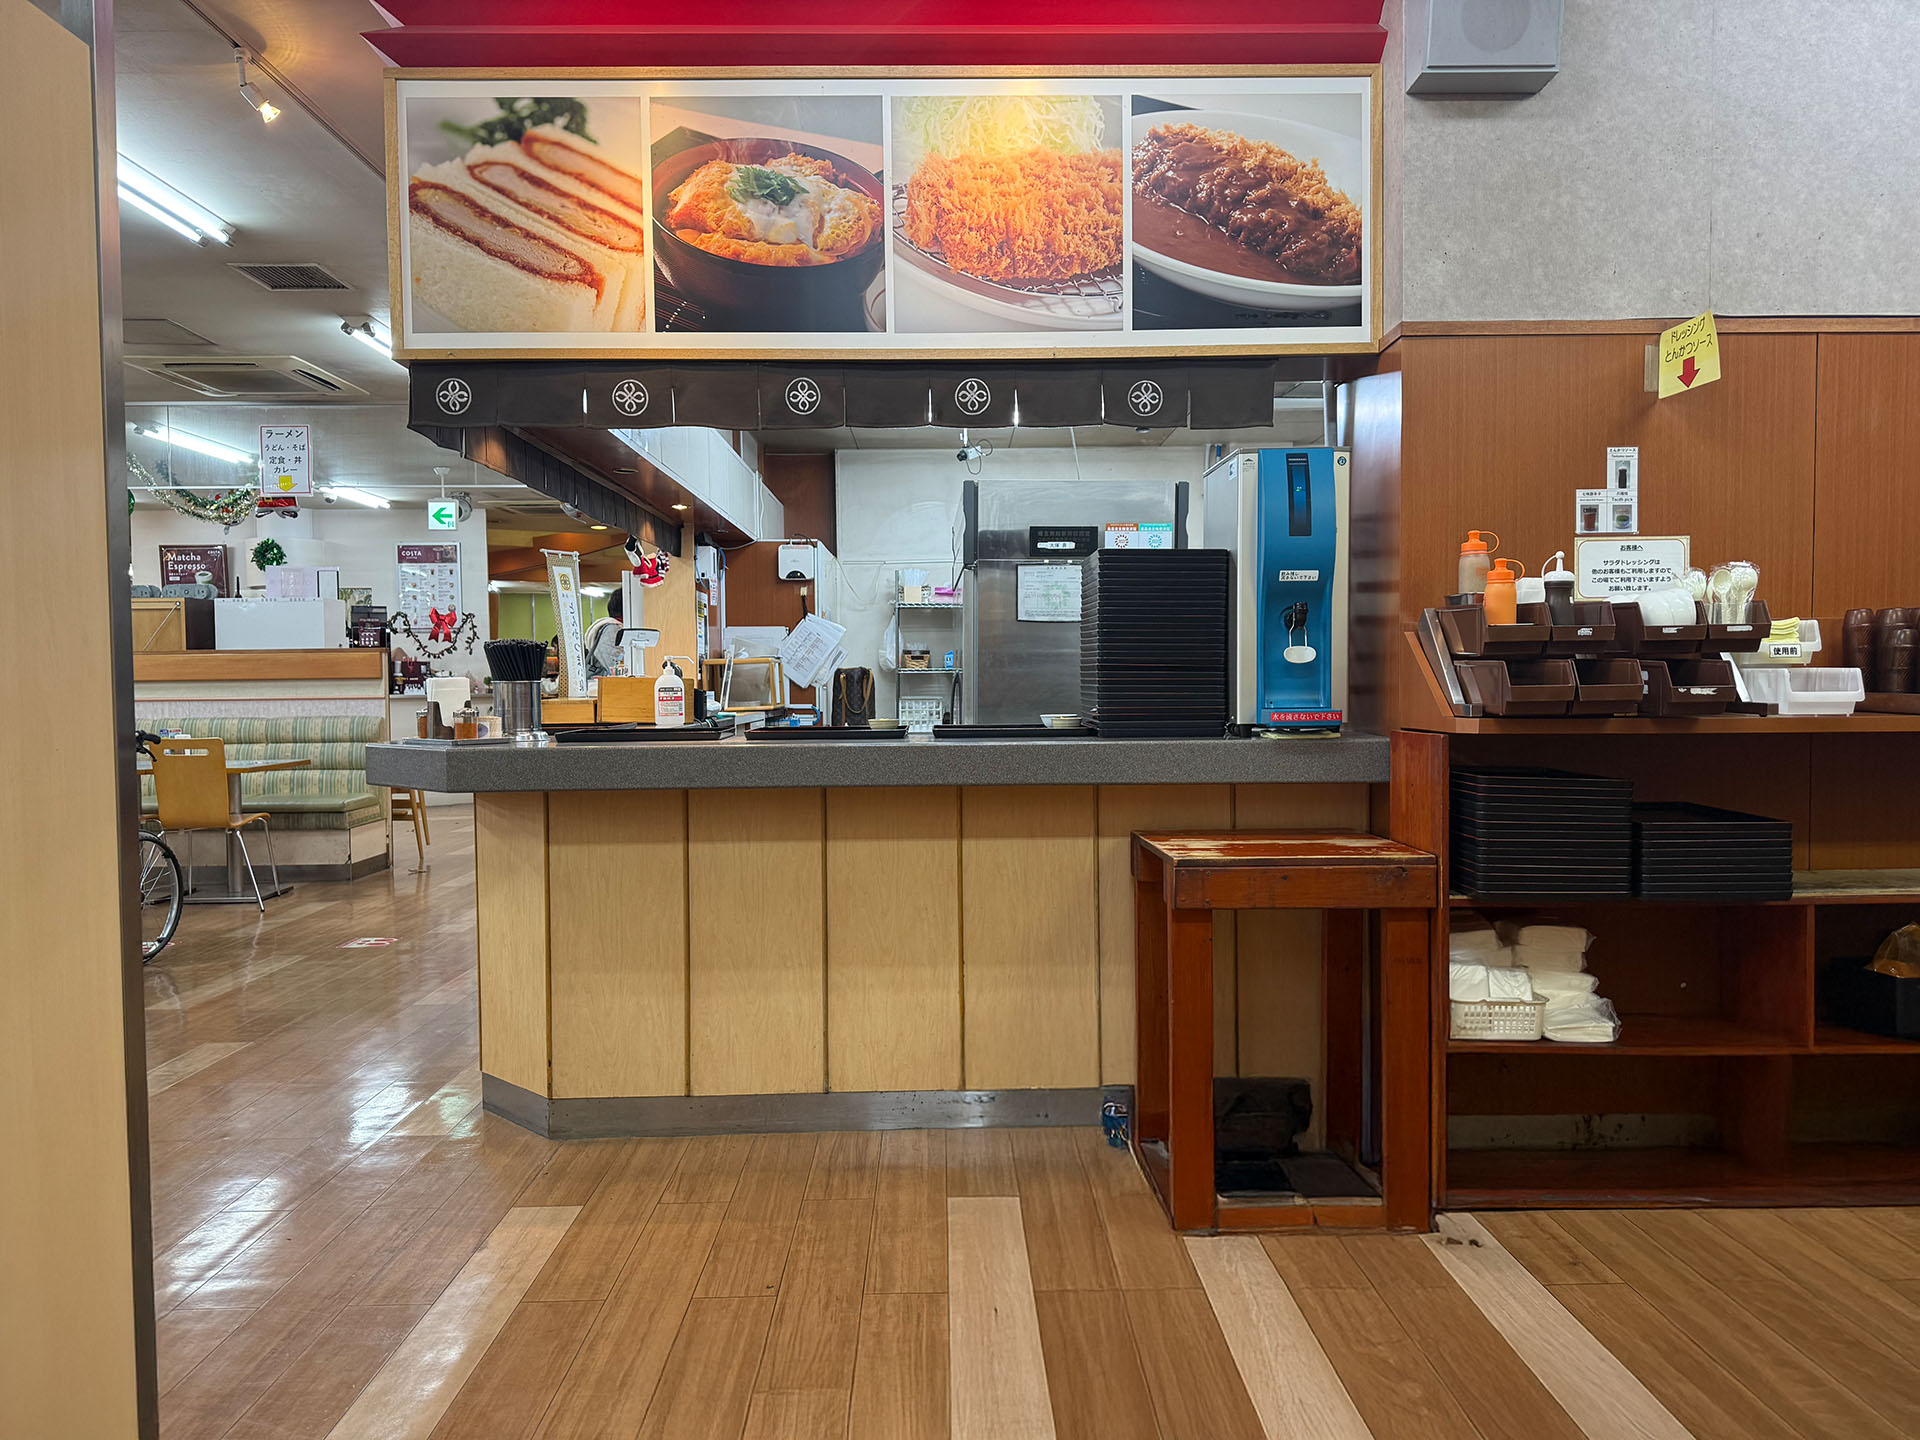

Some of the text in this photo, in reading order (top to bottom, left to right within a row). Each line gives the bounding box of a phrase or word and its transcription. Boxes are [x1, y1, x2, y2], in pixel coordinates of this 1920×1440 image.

[1671, 317, 1705, 343] ドレッシング
[1665, 333, 1713, 362] とんかつソース
[265, 429, 304, 439] ラーメン
[274, 466, 298, 474] カレー
[1620, 544, 1644, 552] お客様へ
[168, 552, 201, 561] Matcha
[1603, 558, 1661, 566] サラダドレッシングは
[168, 561, 206, 573] Espresso
[1773, 646, 1798, 656] 使用前
[1273, 712, 1340, 721] 水を流さないで下さい
